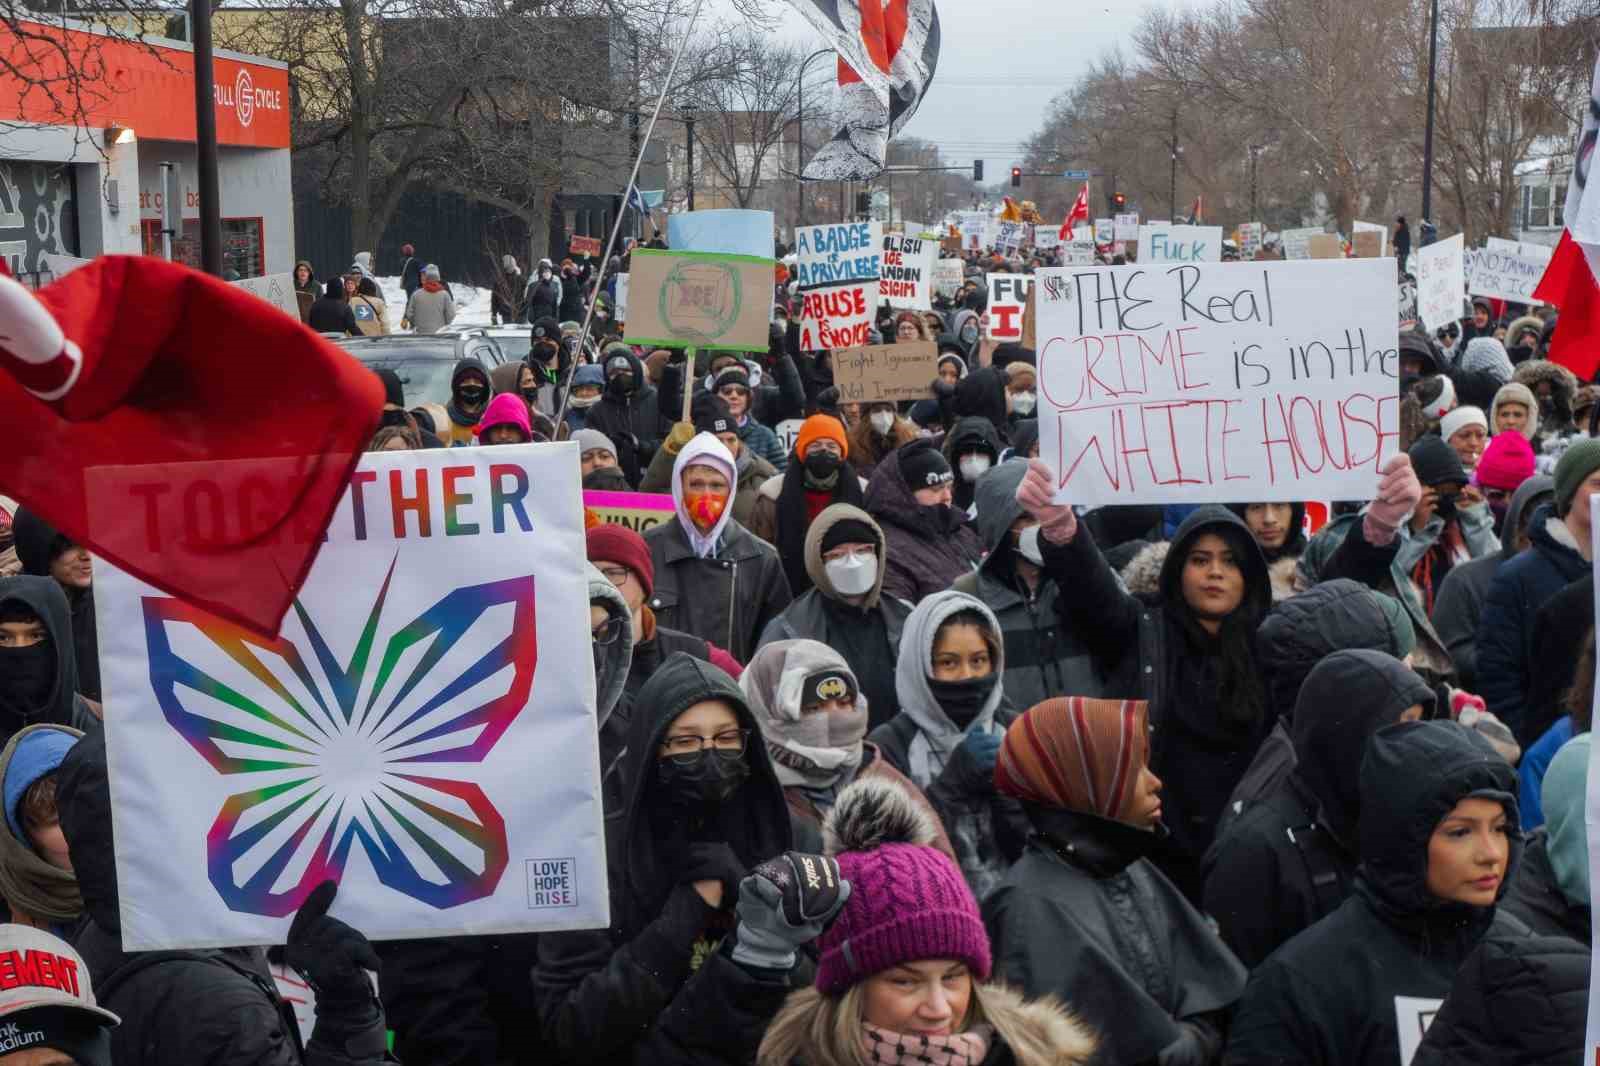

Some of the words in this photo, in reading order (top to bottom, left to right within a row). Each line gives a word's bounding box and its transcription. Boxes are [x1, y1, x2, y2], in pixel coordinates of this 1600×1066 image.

[213, 84, 235, 107] ULL
[255, 87, 281, 110] CYCLE
[798, 232, 810, 255] A
[814, 223, 870, 253] BADGE
[799, 264, 810, 285] A
[811, 255, 879, 283] PRIVILEGE
[884, 252, 903, 266] ICE
[802, 287, 865, 320] ABUSE
[994, 279, 1035, 302] FU
[1073, 270, 1163, 336] THE
[1167, 265, 1273, 327] Real
[801, 328, 812, 352] A
[837, 351, 875, 377] Fight
[1040, 326, 1209, 408] CRIME
[1232, 341, 1270, 389] is
[840, 382, 864, 400] Not
[1058, 399, 1250, 492] WHITE
[1262, 393, 1400, 486] HOUSE
[534, 862, 569, 876] LOVE
[534, 876, 569, 890] HOPE
[535, 890, 571, 905] RISE
